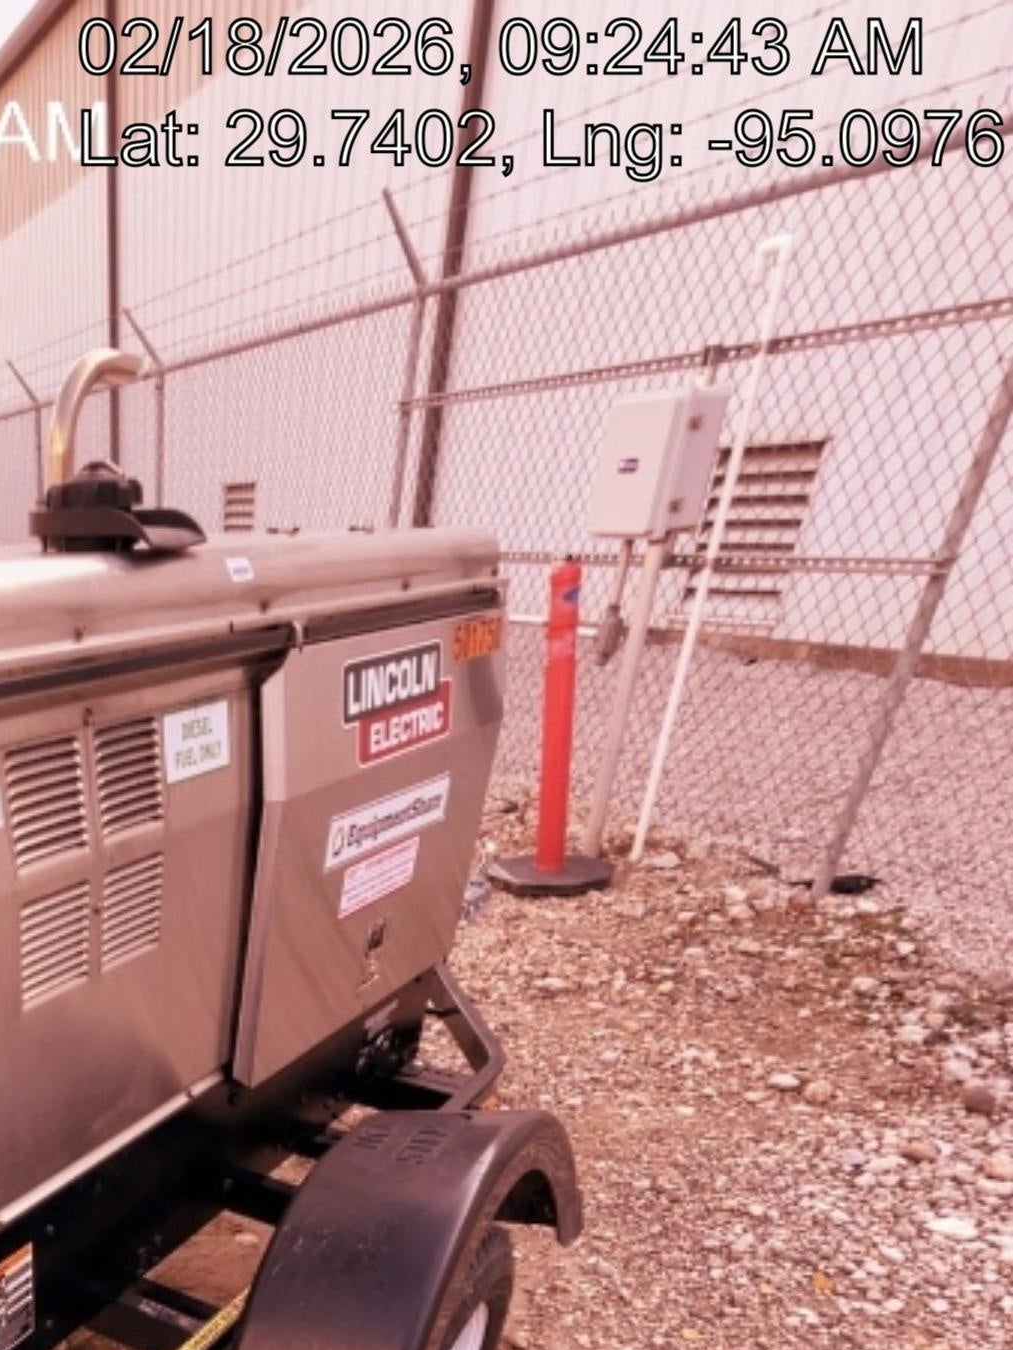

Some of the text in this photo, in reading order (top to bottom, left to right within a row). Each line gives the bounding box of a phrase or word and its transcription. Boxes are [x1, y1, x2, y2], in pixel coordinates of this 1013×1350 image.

[348, 651, 437, 717] LINCOLN
[174, 740, 221, 770] FUEL ONLY
[181, 717, 213, 742] DIESEL
[370, 701, 444, 755] ELECTRIC
[347, 794, 443, 848] EquipmentShare
